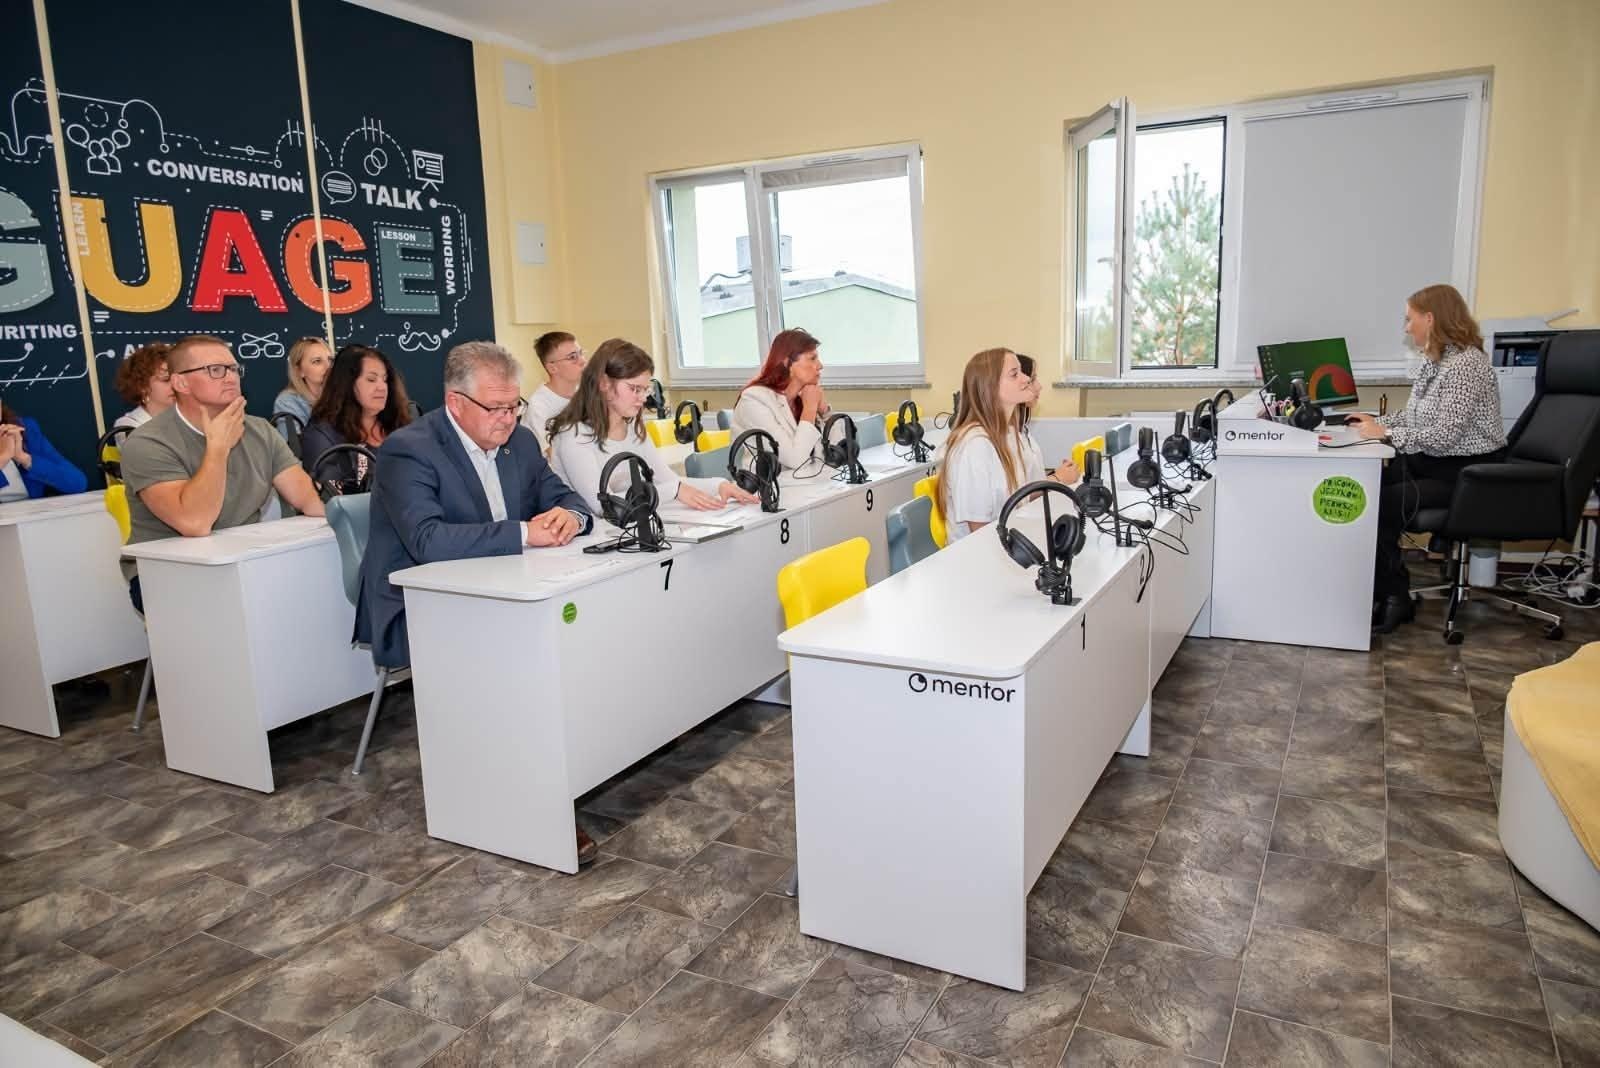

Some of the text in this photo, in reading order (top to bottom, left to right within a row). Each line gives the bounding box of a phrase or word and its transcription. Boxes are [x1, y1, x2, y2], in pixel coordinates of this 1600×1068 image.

[147, 158, 304, 193] CONVERSATION
[361, 183, 423, 211] TALK
[72, 202, 89, 256] LEARN
[381, 230, 416, 241] LESSON
[441, 215, 456, 295] WORDING
[0, 324, 77, 340] RITING
[1238, 431, 1284, 442] mentor
[866, 489, 874, 512] 9
[780, 518, 790, 544] 8
[660, 558, 674, 591] 7
[1081, 612, 1086, 651] 1
[932, 675, 1016, 703] mentor
